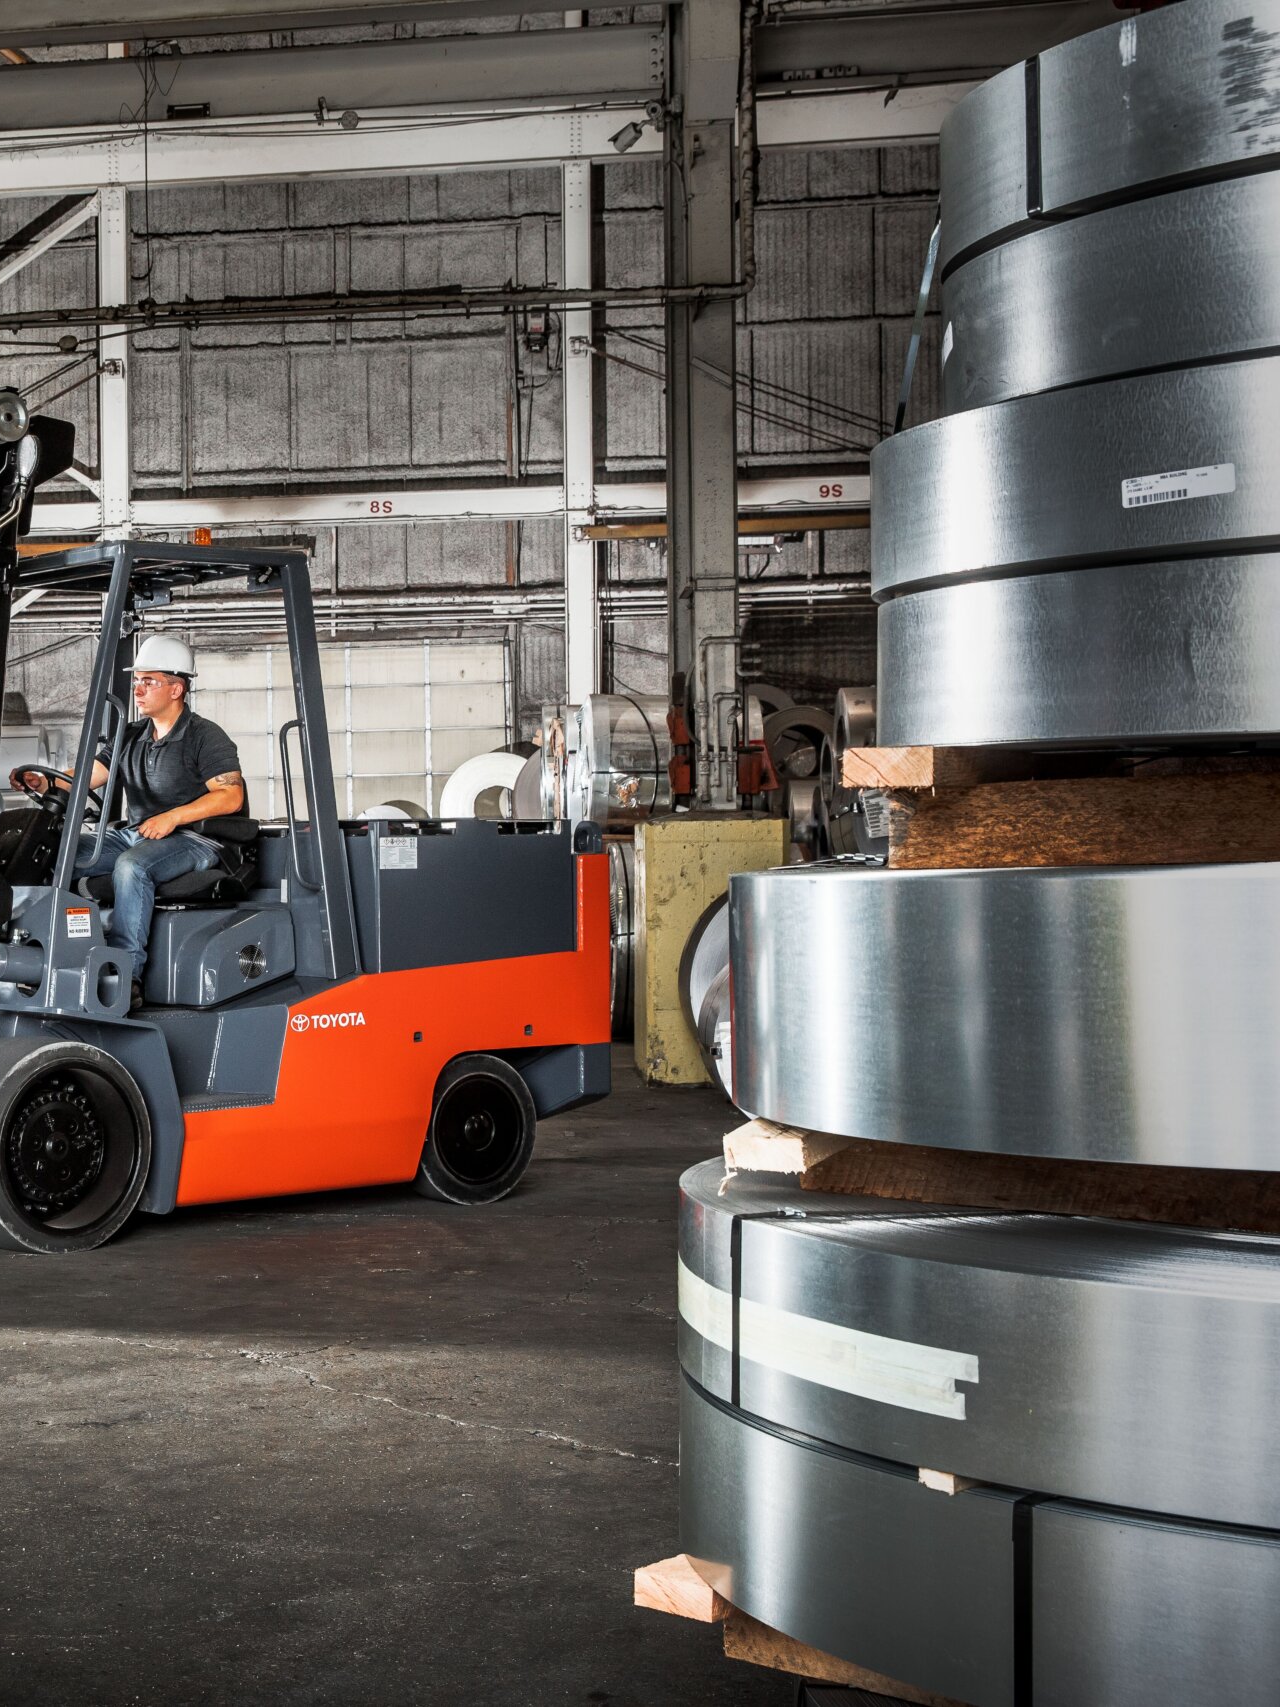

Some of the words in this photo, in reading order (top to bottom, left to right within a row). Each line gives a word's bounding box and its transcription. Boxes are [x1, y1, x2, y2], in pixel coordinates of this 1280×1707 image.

[819, 484, 843, 498] 9S
[370, 500, 393, 513] 8S
[311, 1012, 366, 1029] TOYOTA
